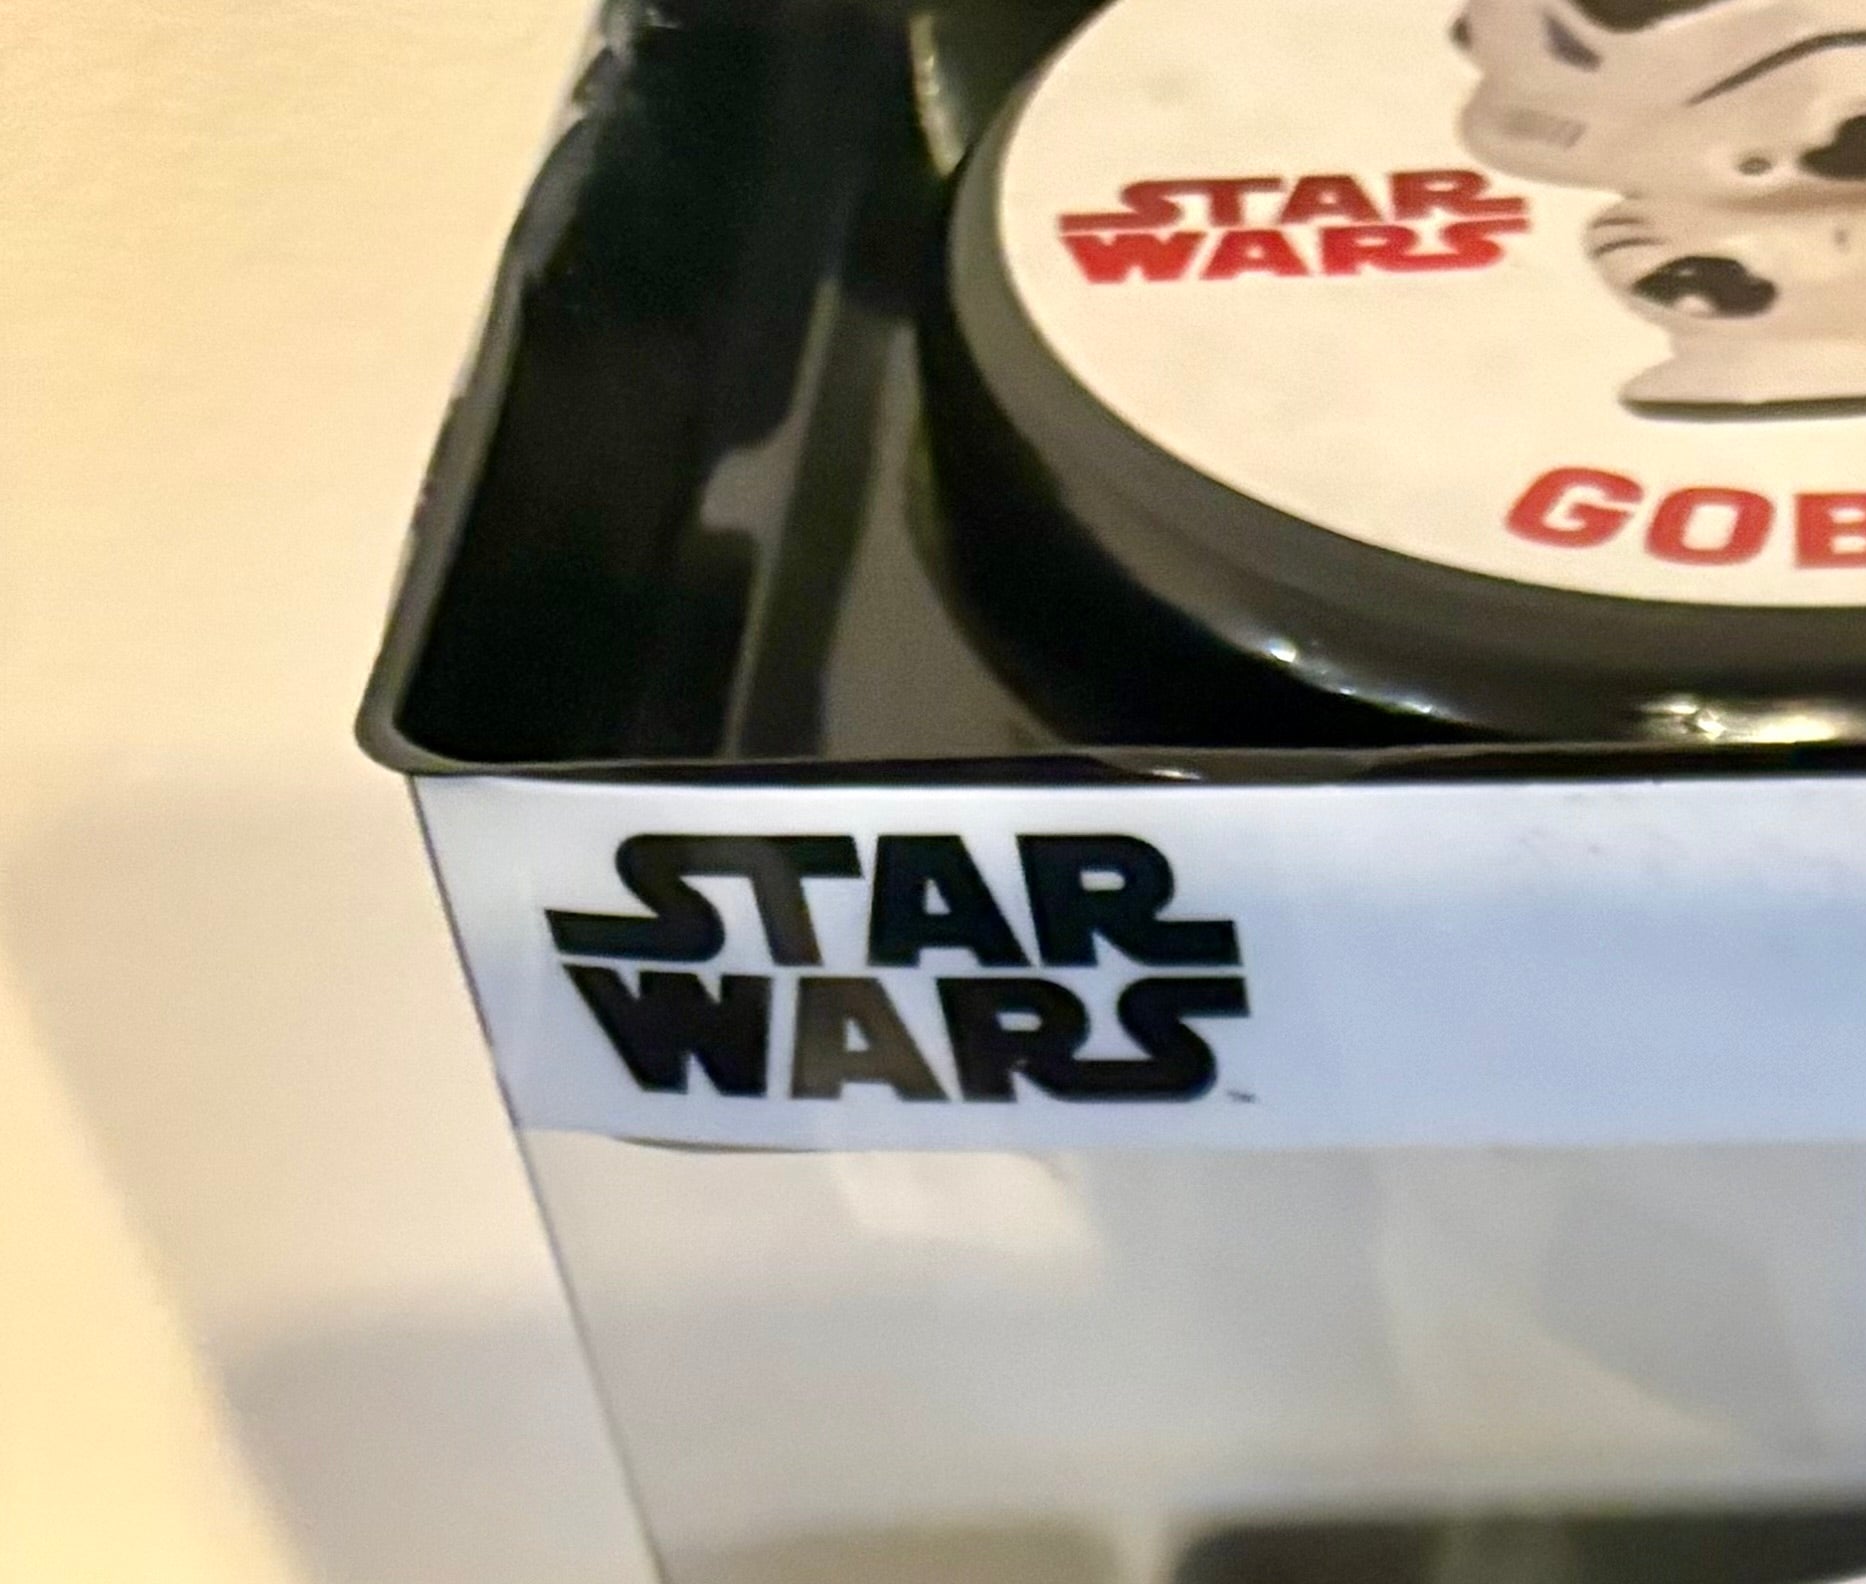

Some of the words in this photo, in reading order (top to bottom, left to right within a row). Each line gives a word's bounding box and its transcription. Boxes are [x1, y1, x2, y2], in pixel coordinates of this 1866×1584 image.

[1056, 169, 1526, 232] STAR
[1060, 221, 1529, 285] WARS
[544, 834, 1241, 967] STAR
[563, 965, 1249, 1101] WARS
